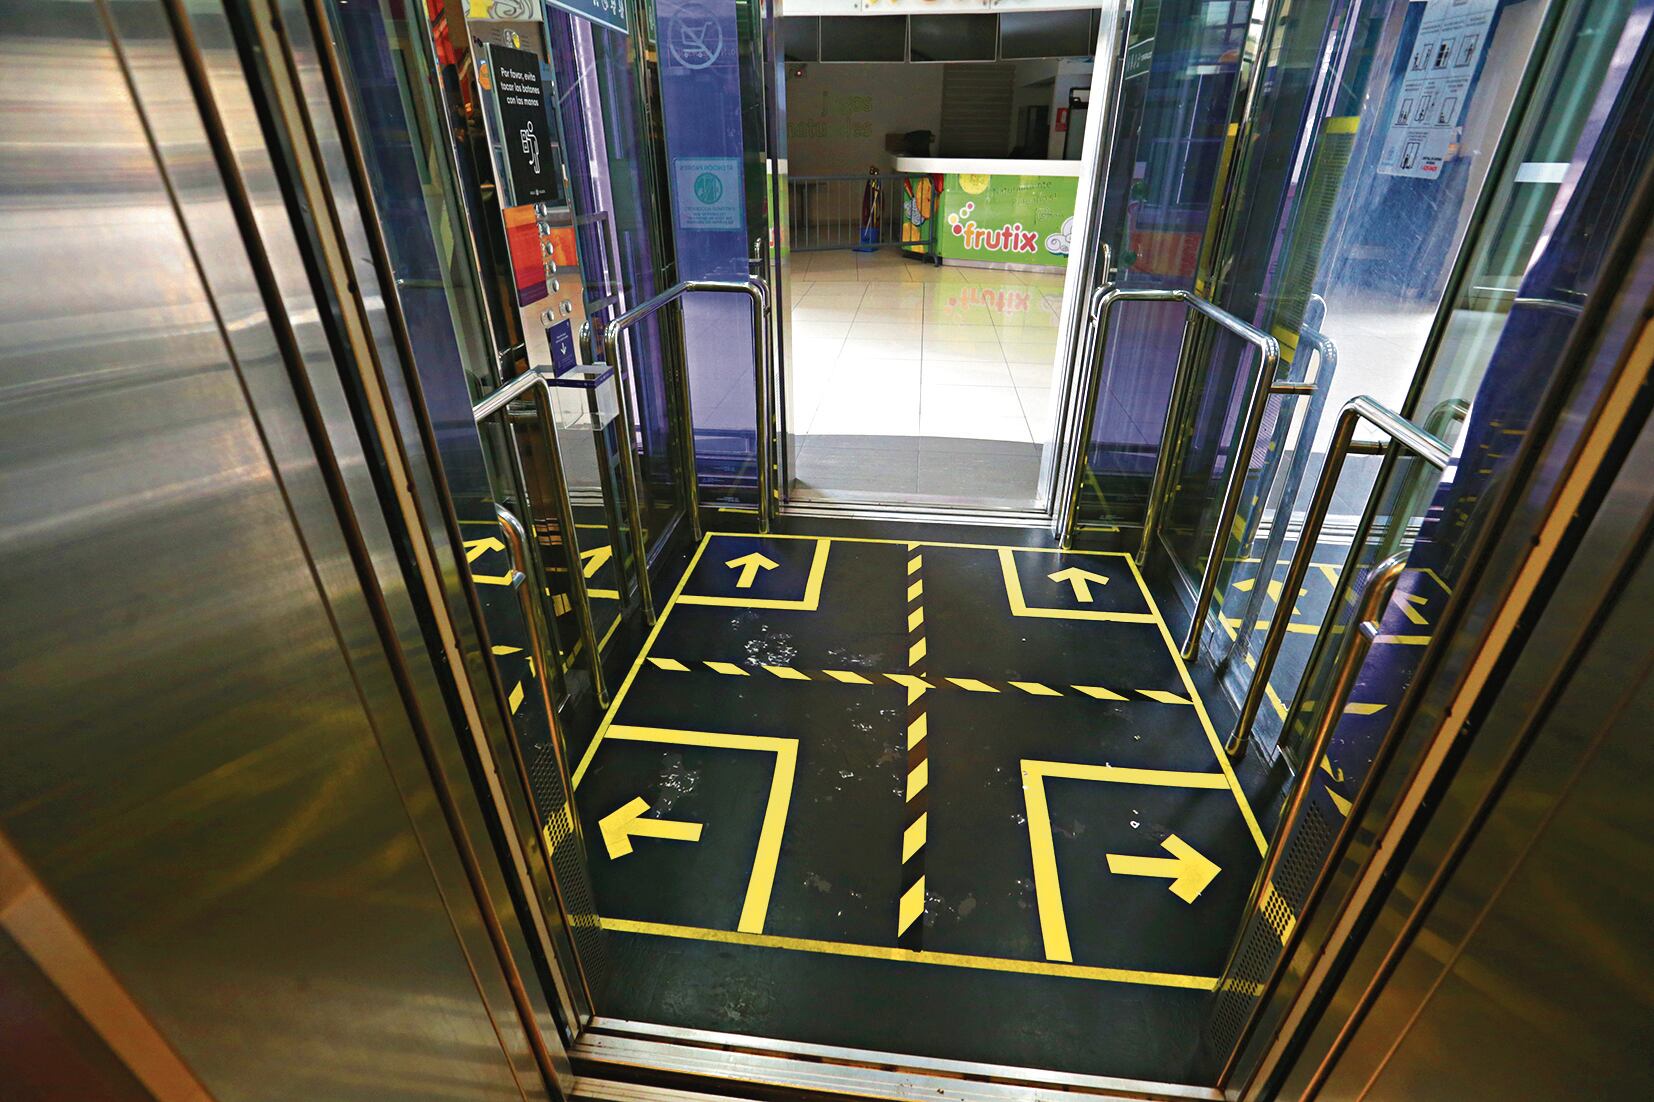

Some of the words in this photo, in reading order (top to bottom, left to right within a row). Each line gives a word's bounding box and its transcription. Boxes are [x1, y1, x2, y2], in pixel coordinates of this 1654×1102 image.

[500, 67, 509, 77] Por
[525, 71, 536, 82] evita
[500, 81, 514, 91] tocar
[514, 82, 522, 92] los
[522, 83, 540, 95] botones
[506, 96, 516, 104] con
[524, 98, 539, 107] manos
[963, 221, 1038, 253] frutix
